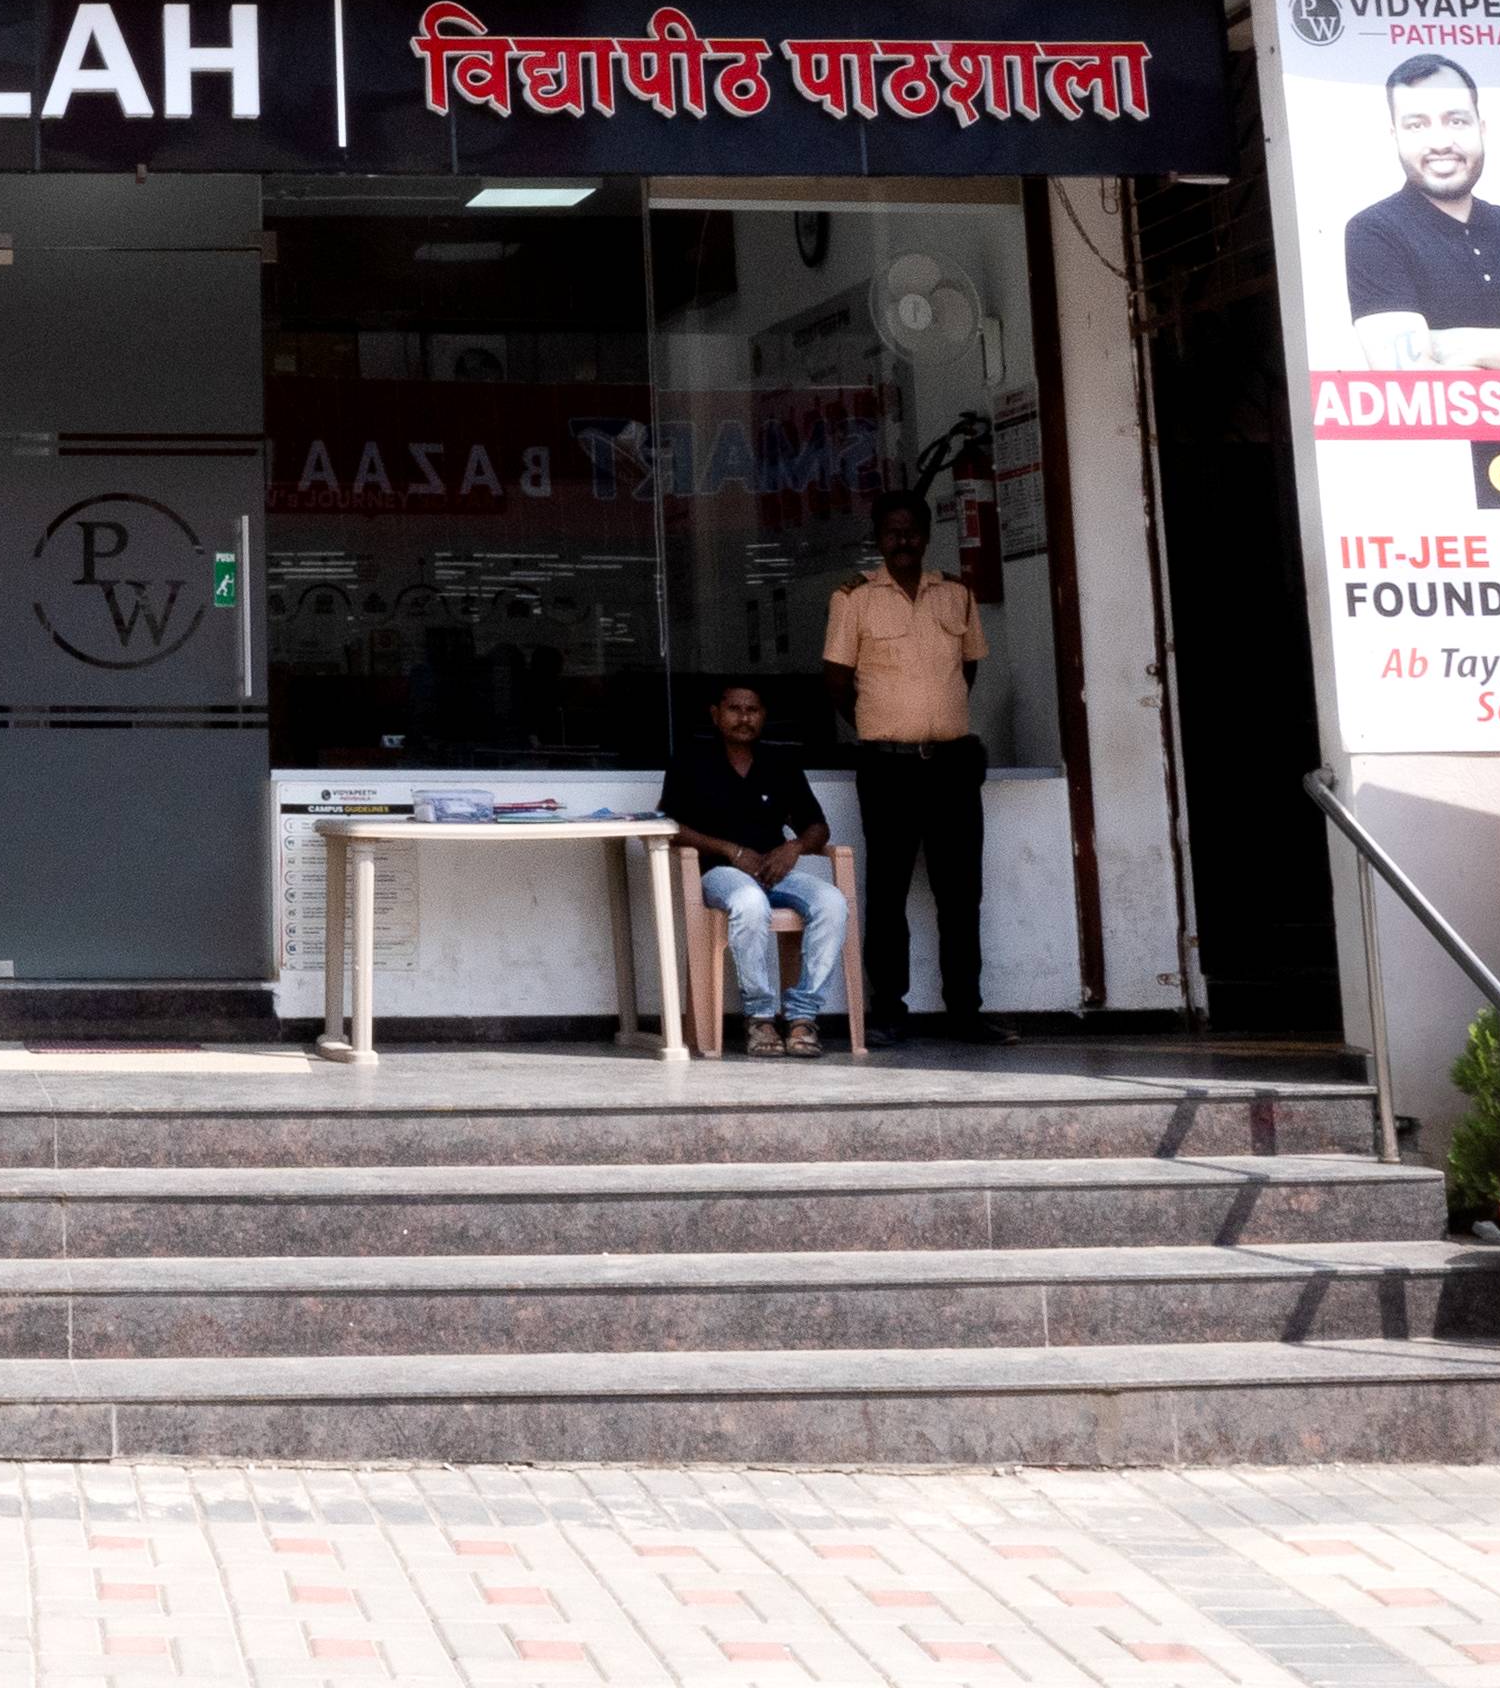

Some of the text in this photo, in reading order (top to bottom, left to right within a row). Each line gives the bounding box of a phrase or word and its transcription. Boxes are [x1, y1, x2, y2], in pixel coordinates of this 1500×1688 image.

[411, 0, 1154, 129] विद्यापीठ पाठशाला
[215, 552, 236, 562] PUSH
[1340, 535, 1491, 570] IIT-JEE
[1381, 647, 1429, 680] Ab
[307, 805, 390, 813] CAMPUS GUIDELINES
